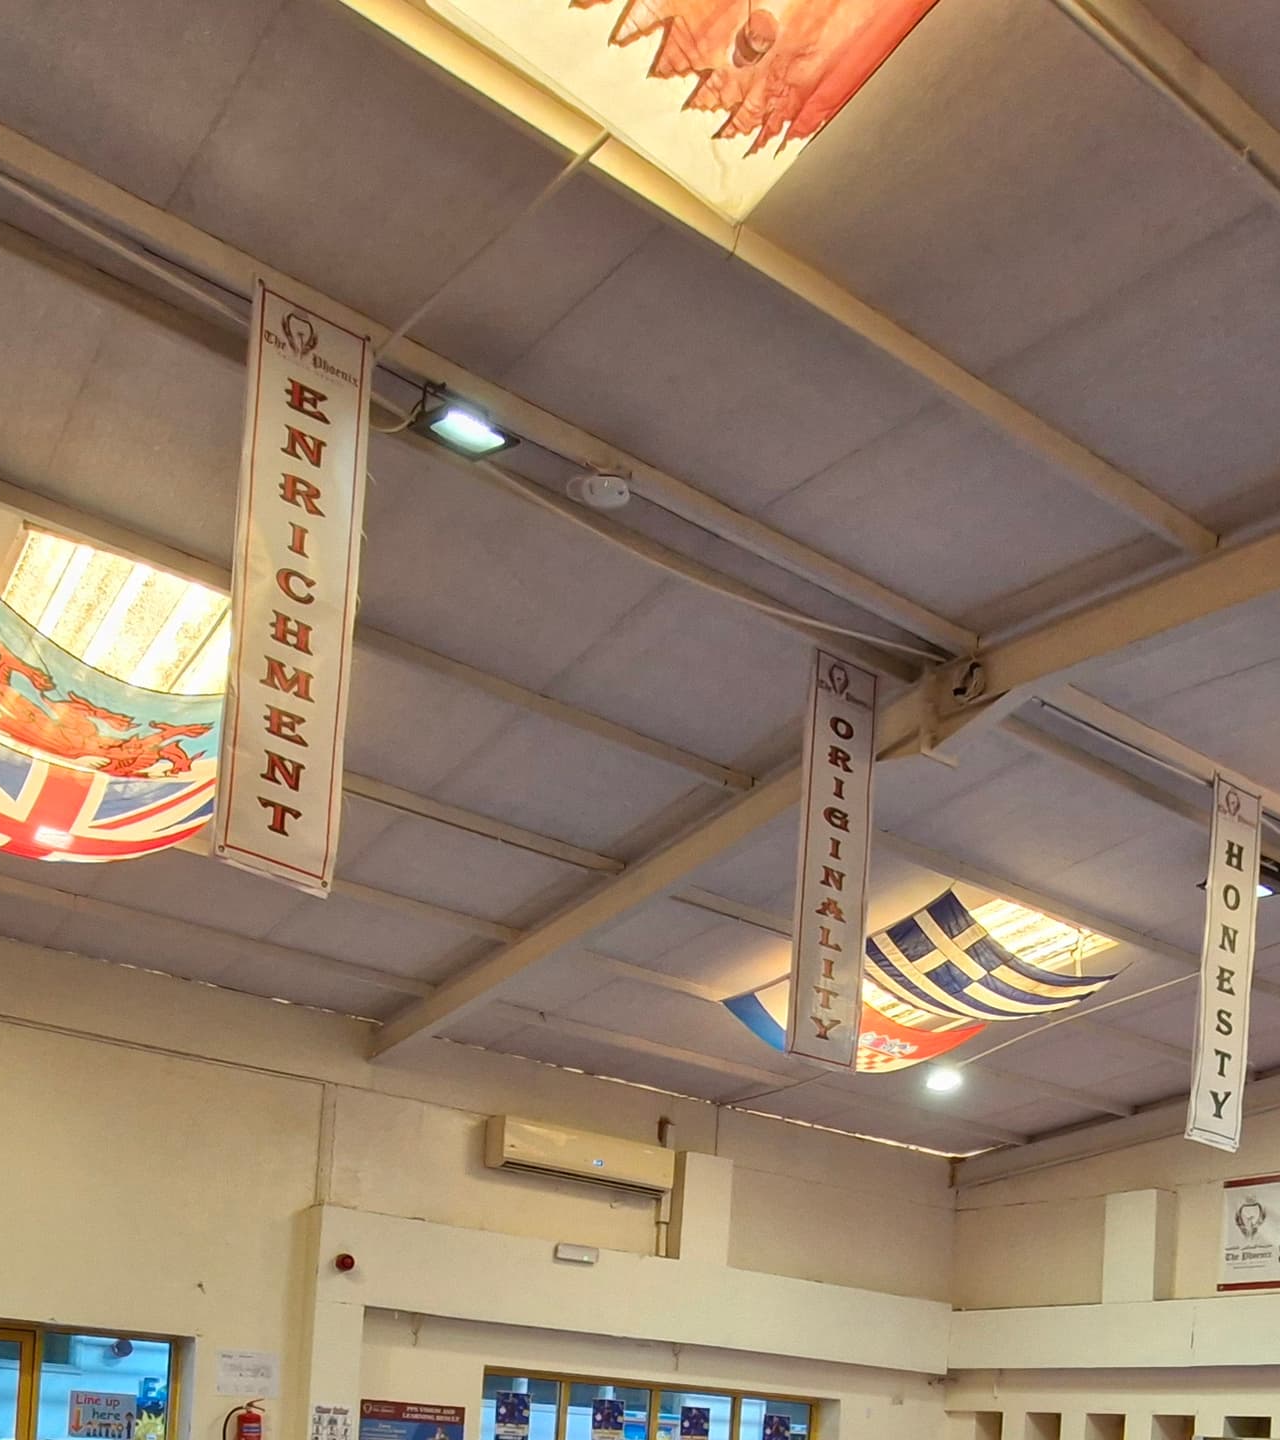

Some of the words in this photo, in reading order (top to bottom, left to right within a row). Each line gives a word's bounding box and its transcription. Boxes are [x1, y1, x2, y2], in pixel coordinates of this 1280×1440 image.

[312, 353, 358, 387] Phoenix
[256, 377, 329, 836] ENRICHMENT
[815, 716, 854, 1040] ORIGINALITY
[1209, 839, 1245, 1119] HONESTY
[75, 1393, 101, 1405] Line
[105, 1399, 120, 1409] up
[92, 1408, 121, 1420] here
